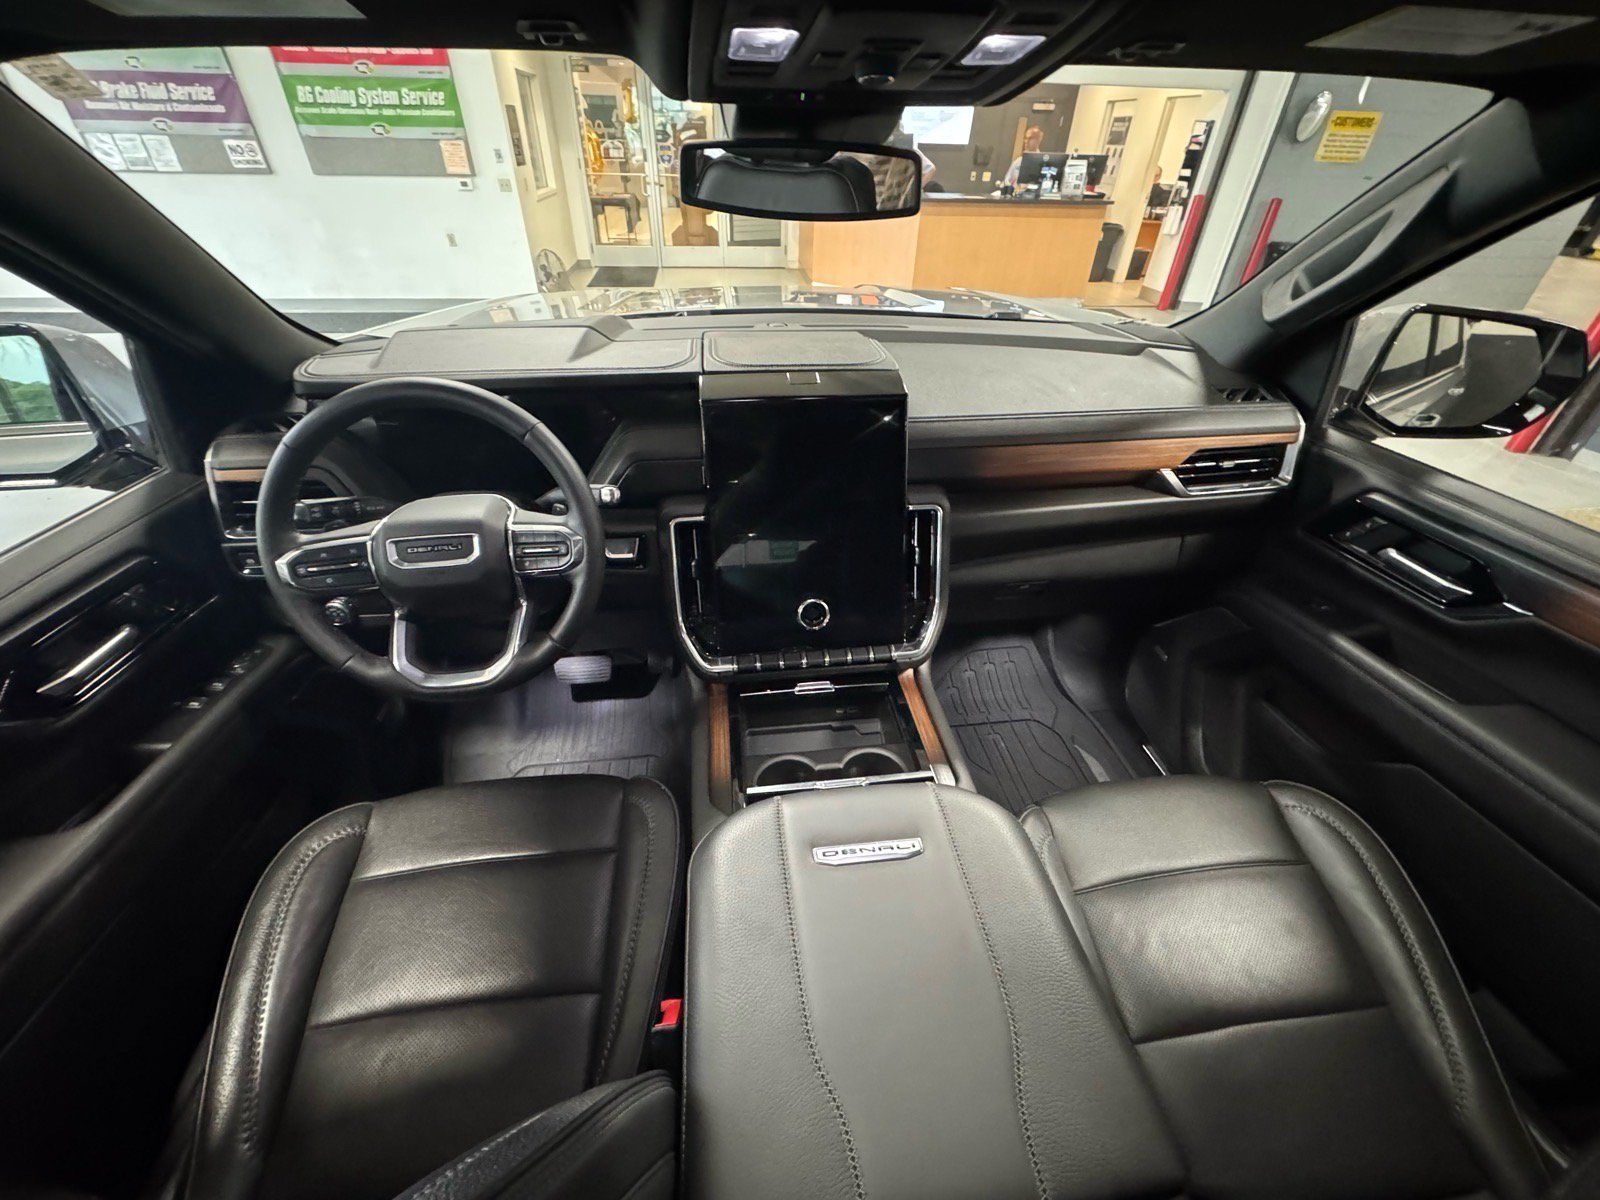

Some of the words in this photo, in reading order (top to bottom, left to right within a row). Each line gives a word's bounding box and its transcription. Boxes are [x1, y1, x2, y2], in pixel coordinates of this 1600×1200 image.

[167, 82, 216, 101] Service
[296, 85, 314, 103] BG
[314, 86, 357, 107] Cooling
[357, 87, 401, 107] System
[401, 87, 445, 106] Service
[228, 144, 245, 155] NO
[406, 543, 463, 553] DENALI
[822, 843, 916, 857] DENALI
